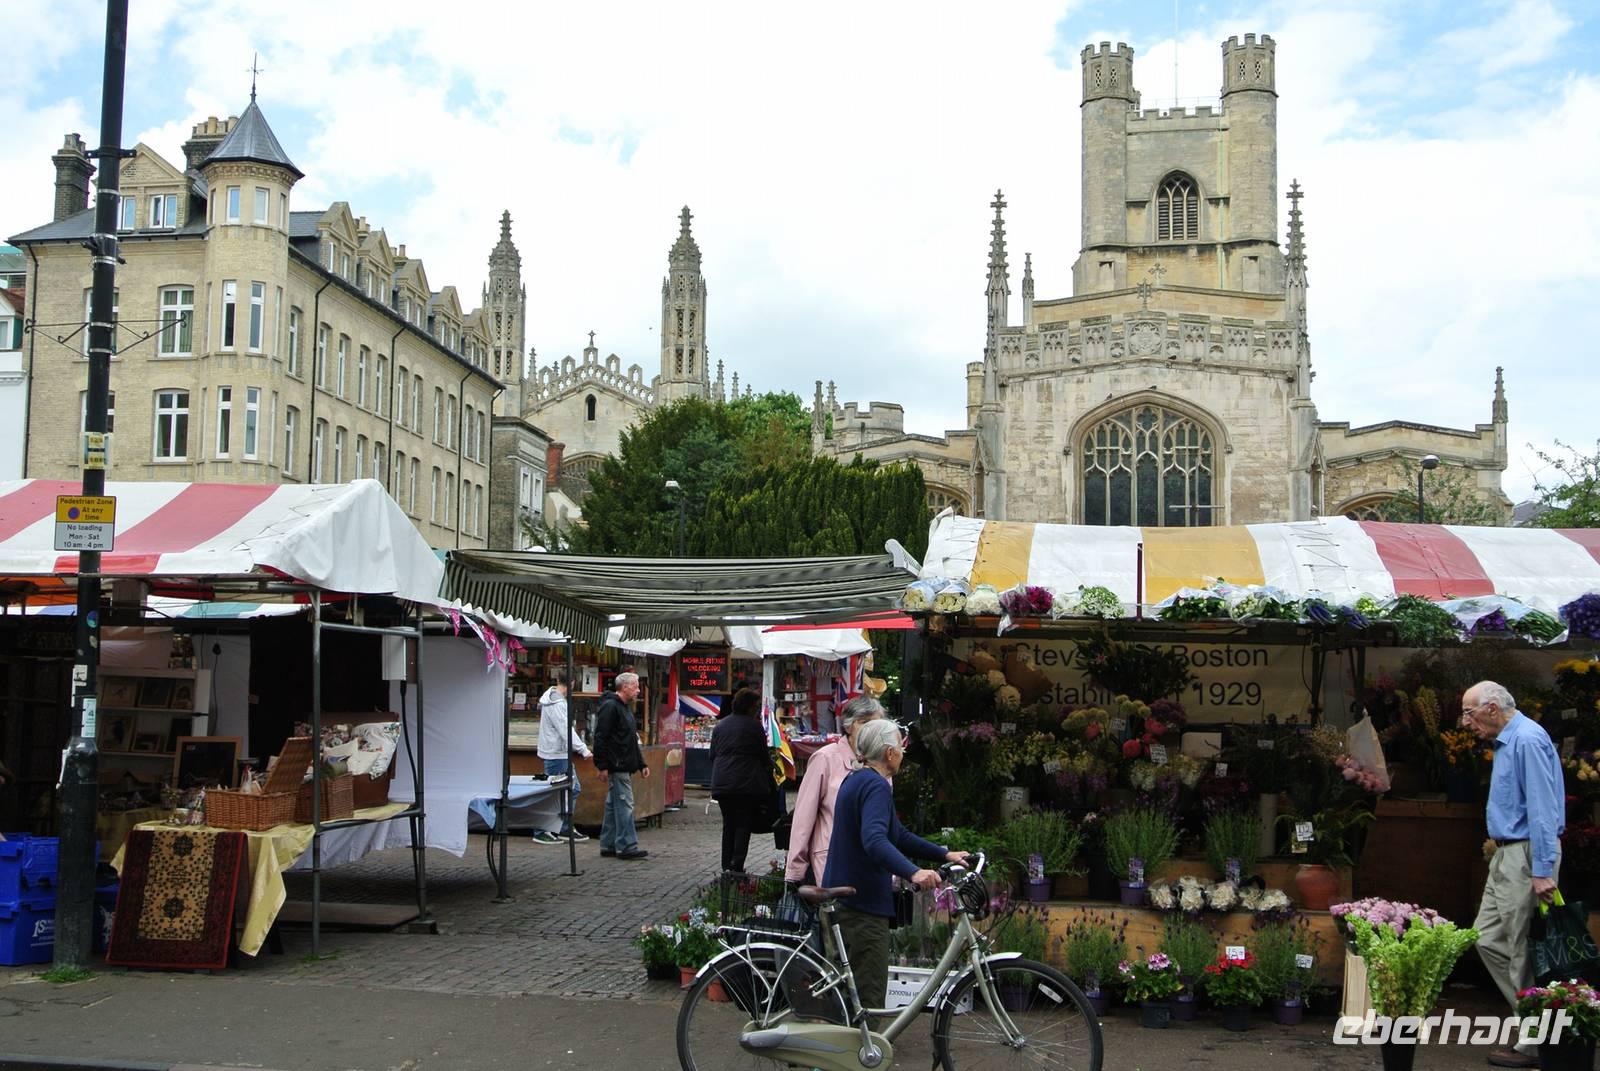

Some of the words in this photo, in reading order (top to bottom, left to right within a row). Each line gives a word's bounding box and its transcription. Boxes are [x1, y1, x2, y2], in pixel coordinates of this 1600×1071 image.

[79, 524, 103, 532] loading
[1171, 644, 1269, 667] Boston
[1192, 682, 1262, 706] 1929
